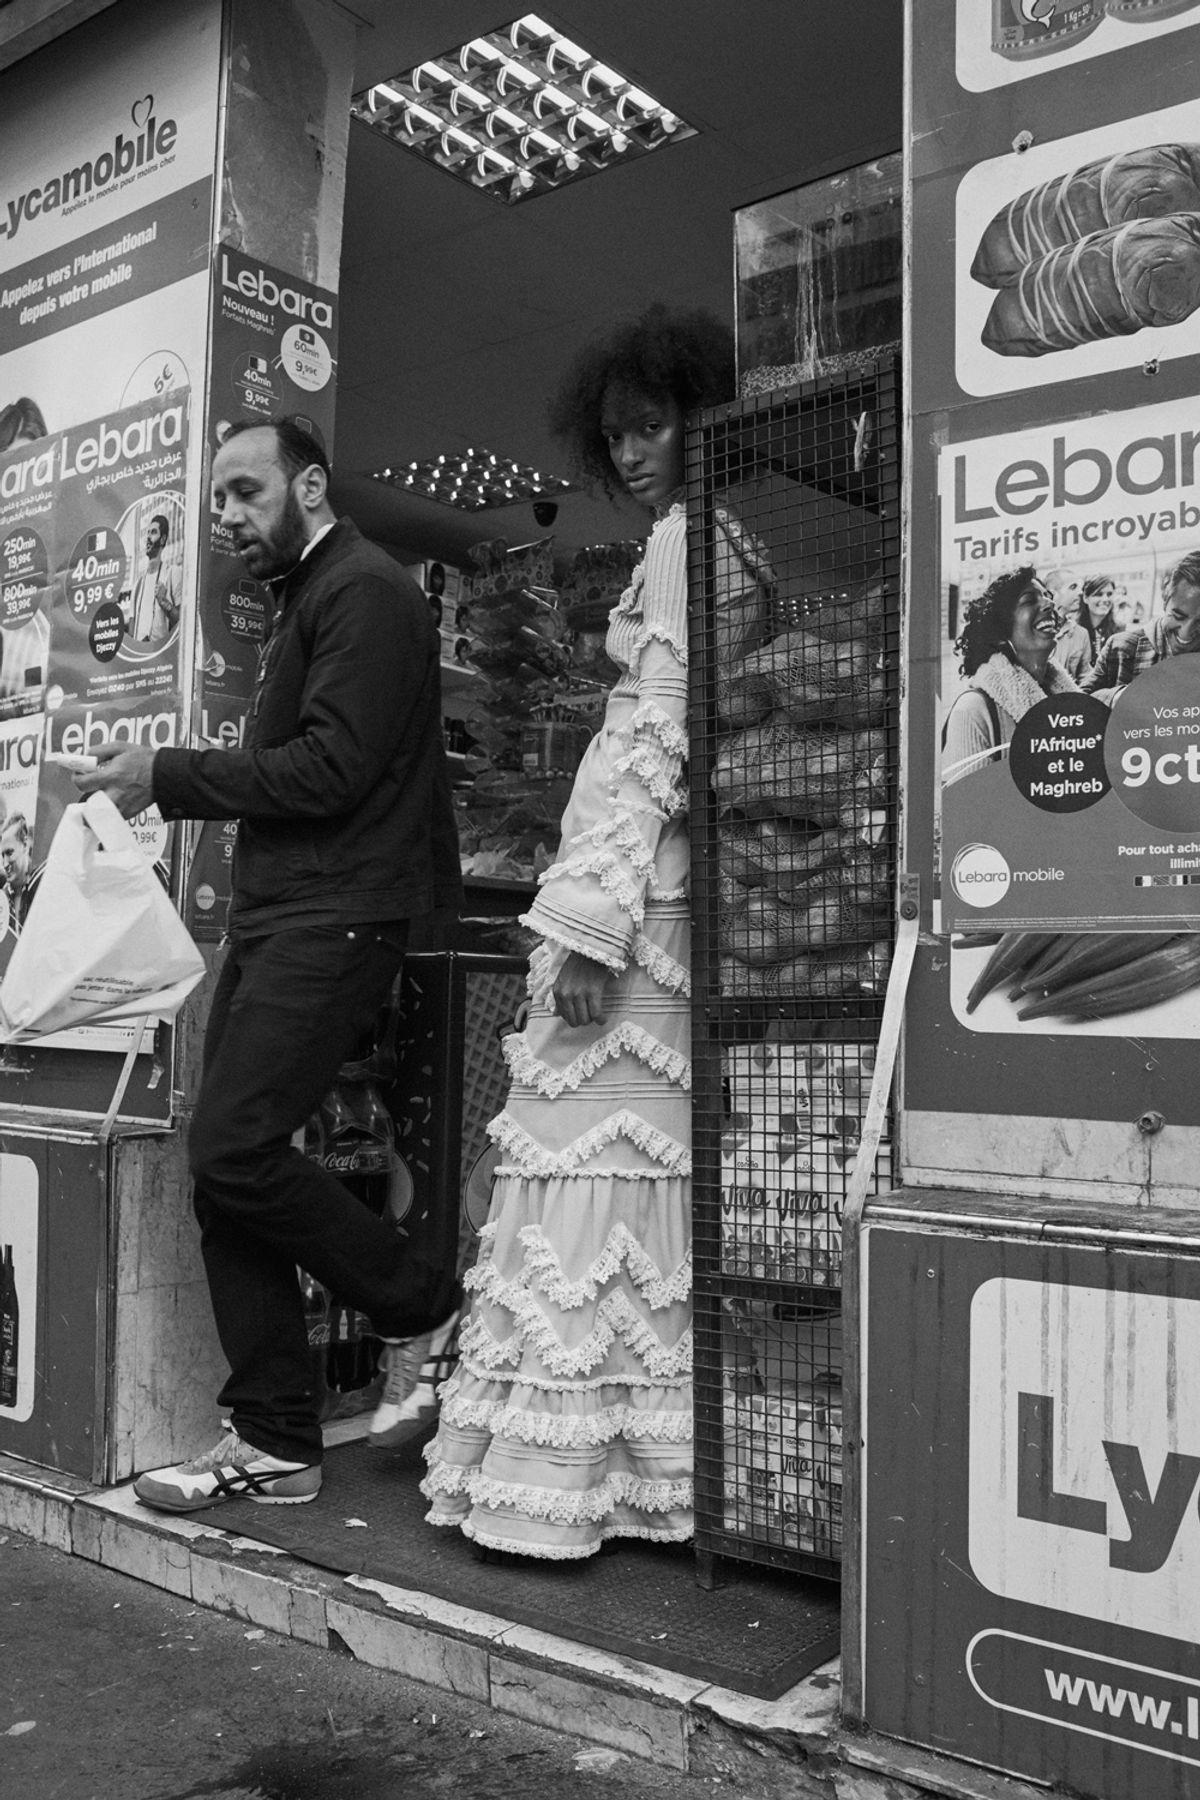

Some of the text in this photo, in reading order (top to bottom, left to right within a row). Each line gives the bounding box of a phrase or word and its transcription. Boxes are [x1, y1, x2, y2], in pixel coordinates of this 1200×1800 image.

[0, 279, 44, 309] Appelez
[46, 264, 72, 288] vers
[19, 263, 133, 326] depuis votre mobile
[222, 254, 332, 329] Lebara
[223, 295, 268, 323] Nouveau
[294, 340, 320, 359] 60min
[244, 369, 272, 388] 40min
[60, 406, 183, 481] Lebara
[954, 430, 1200, 524] Lebar
[1051, 500, 1200, 548] incroyab
[4, 536, 36, 556] 250min
[954, 526, 1040, 562] Tarifs
[72, 556, 120, 582] 40min
[4, 583, 38, 602] 800min
[229, 594, 265, 612] 800min
[1048, 714, 1084, 728] Vers
[1153, 706, 1200, 720] Vos ap
[44, 711, 176, 762] Lebara
[202, 709, 245, 748] Le
[1122, 724, 1200, 740] vers les mo
[1048, 757, 1084, 774] et le
[1121, 744, 1200, 788] 9ct
[1030, 778, 1103, 798] Maghreb
[1118, 845, 1146, 856] Pour
[1149, 844, 1174, 855] tout
[958, 868, 1065, 884] Lebara mobile
[1018, 1391, 1200, 1574] Ly
